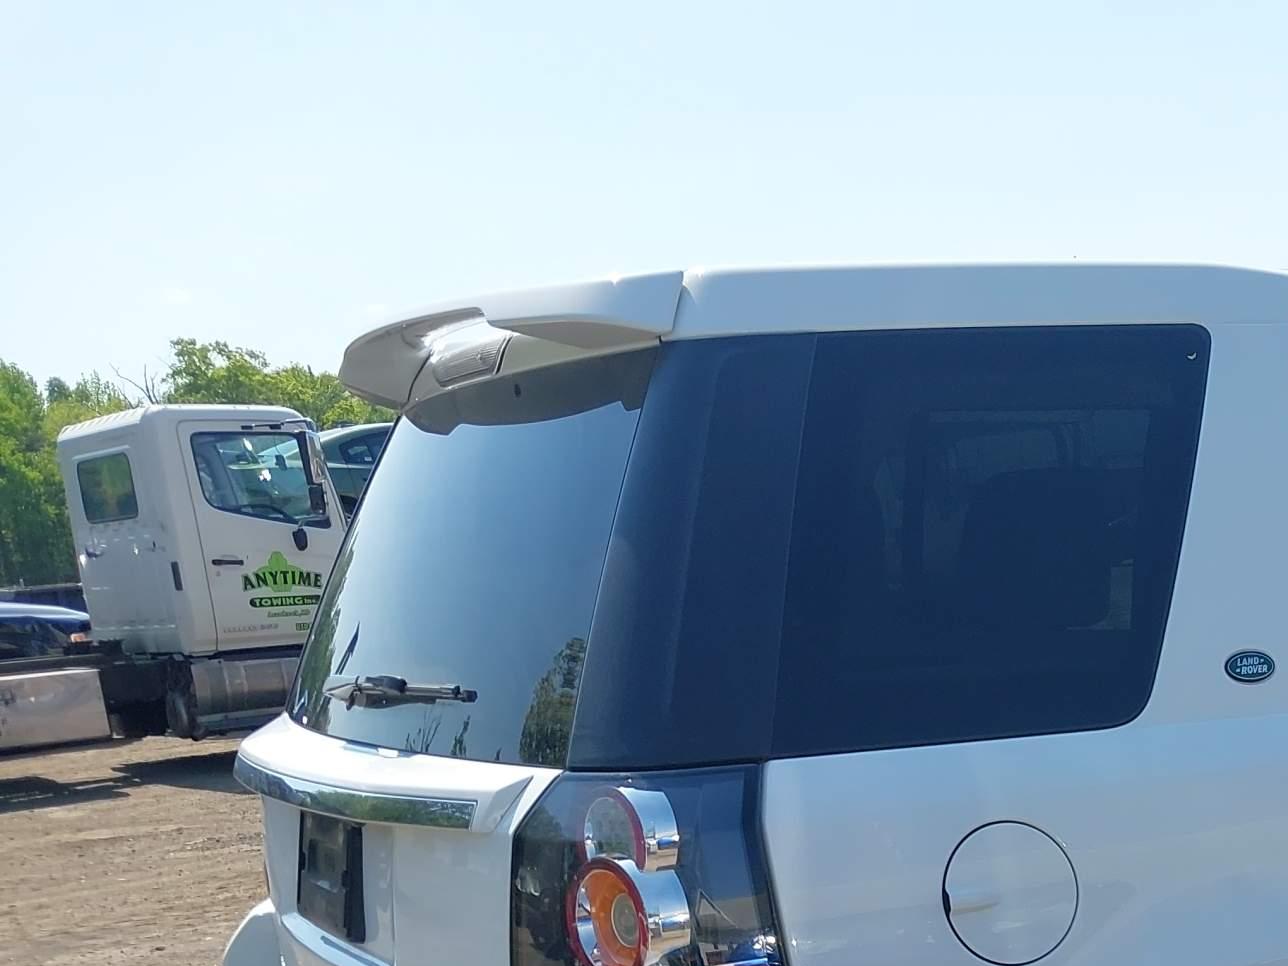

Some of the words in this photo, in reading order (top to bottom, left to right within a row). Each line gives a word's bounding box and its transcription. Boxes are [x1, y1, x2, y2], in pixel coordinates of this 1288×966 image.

[242, 570, 322, 592] ANYTIME
[255, 596, 304, 607] TOWING
[1237, 656, 1259, 667] LAND
[1241, 664, 1268, 675] ROVER
